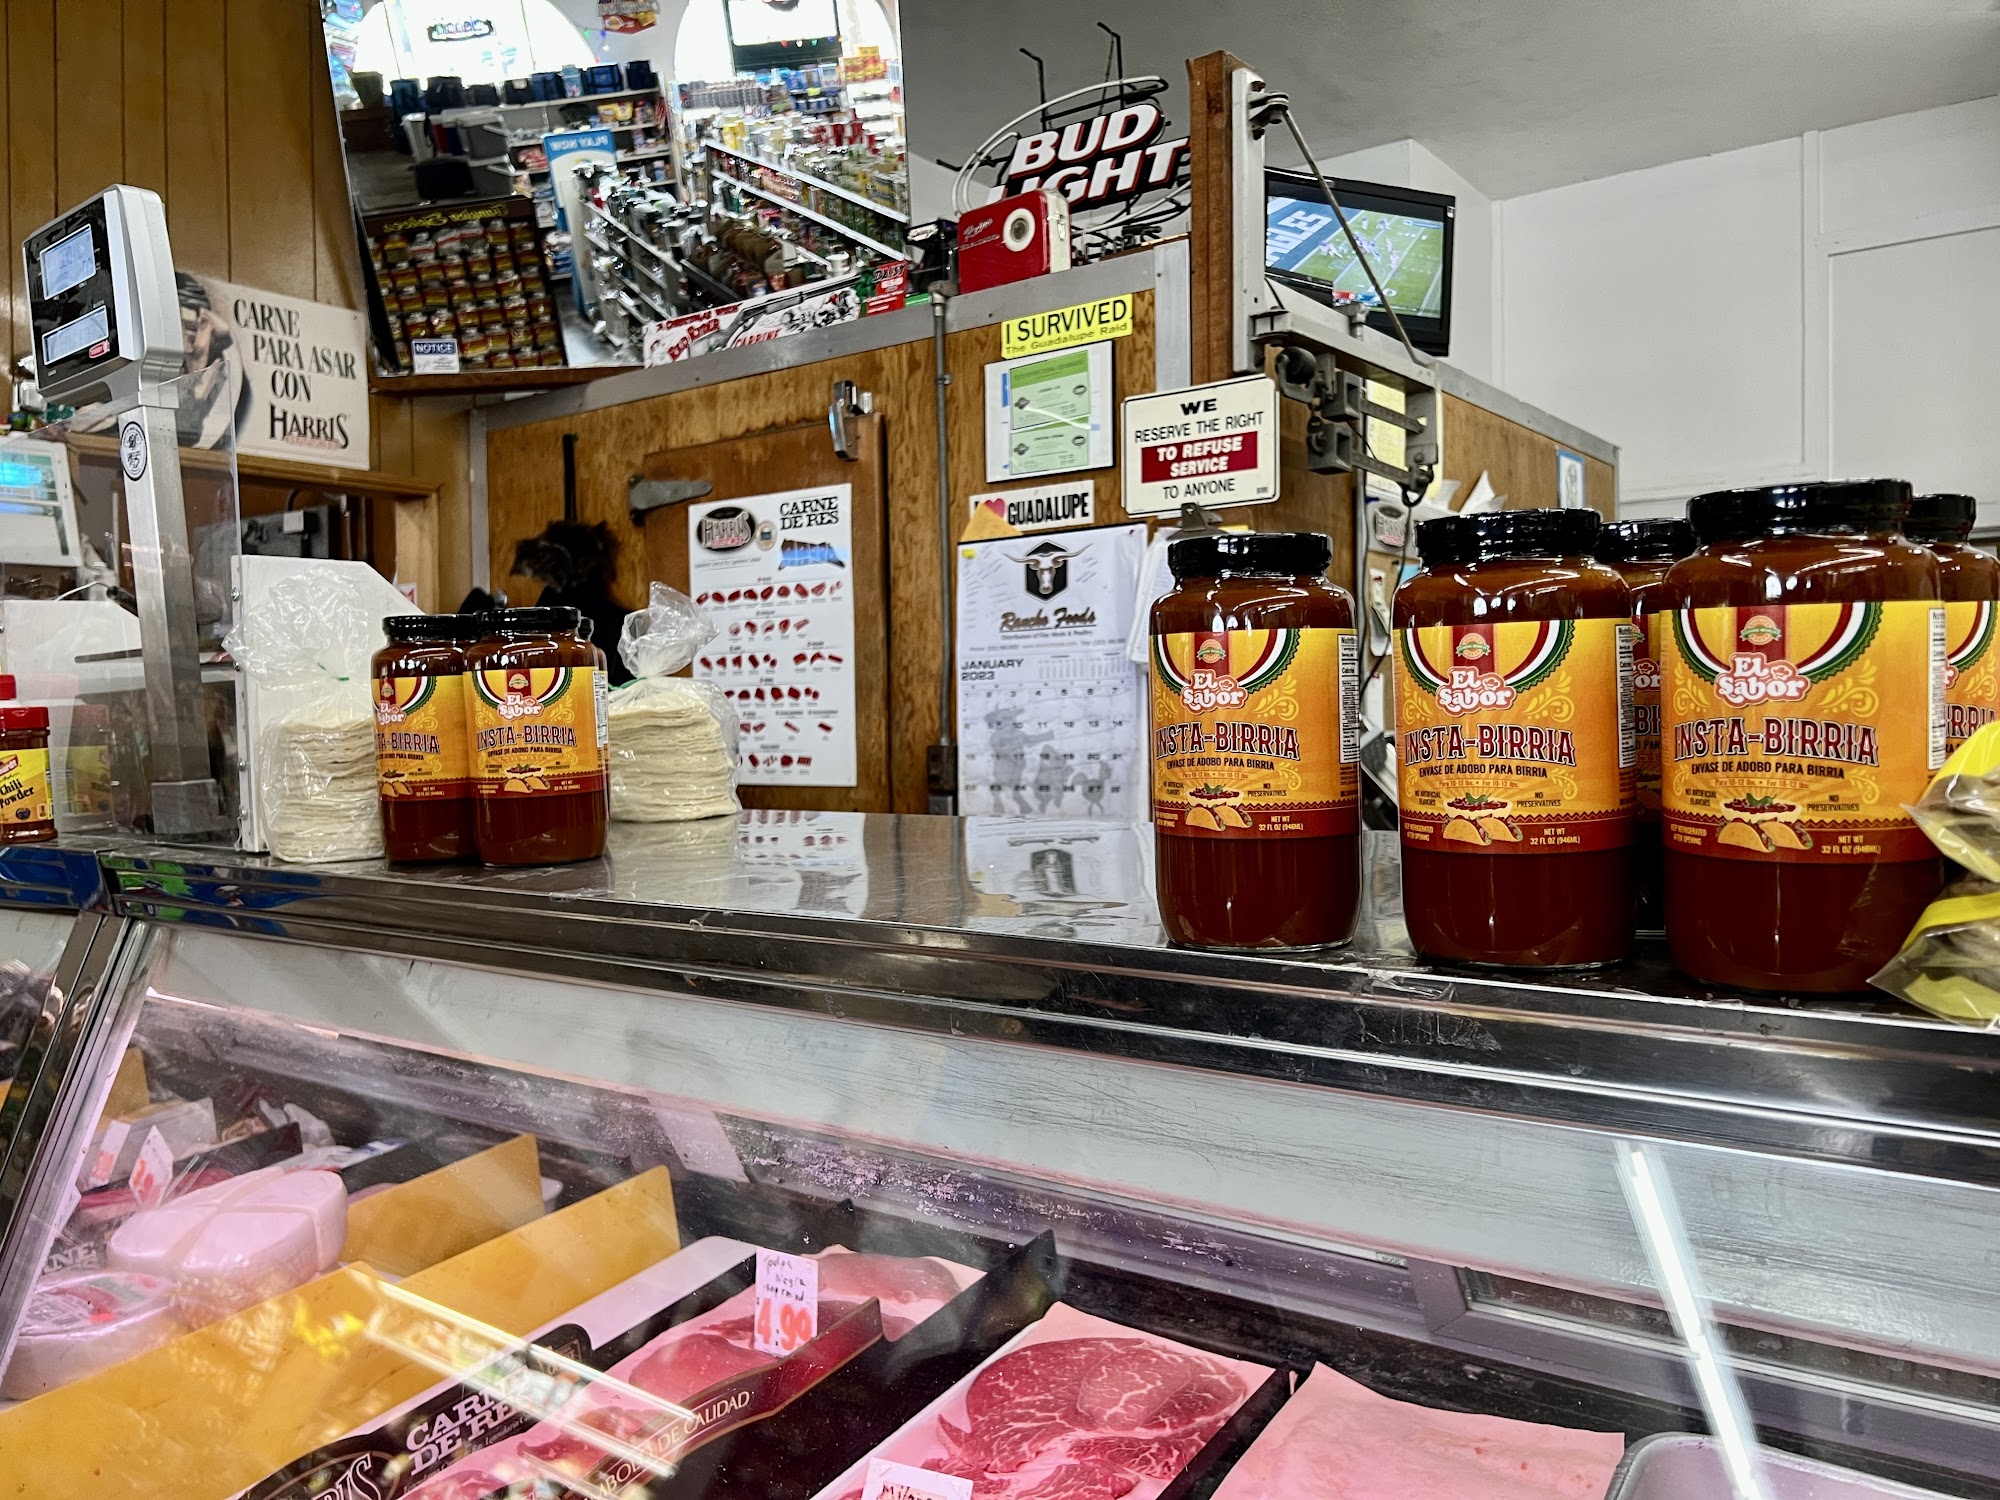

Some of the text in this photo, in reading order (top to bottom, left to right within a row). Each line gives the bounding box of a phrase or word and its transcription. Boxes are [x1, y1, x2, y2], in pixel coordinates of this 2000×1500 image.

[1009, 104, 1161, 175] BUD
[233, 299, 300, 338] CARNE
[1006, 299, 1127, 344] I SURVIVED
[415, 343, 453, 354] NOTICE
[1006, 322, 1127, 354] The Guadalupe Raid
[252, 334, 356, 380] PARA ASAR
[271, 369, 311, 403] CON
[1181, 398, 1217, 416] WE
[269, 401, 349, 449] HARRIS
[1135, 411, 1264, 444] RESERVE THE RIGHT
[1157, 436, 1243, 462] TO REFUSE
[1170, 456, 1229, 477] SERVICE
[1162, 478, 1235, 499] TO ANYONE
[780, 496, 838, 516] CARNE
[1008, 492, 1089, 526] GUADALUPE
[701, 510, 750, 547] HARRIS
[780, 510, 839, 531] DE RES
[1000, 607, 1096, 632] Rancho Foods
[961, 658, 1024, 670] JANUARY
[1734, 657, 1769, 678] El
[961, 672, 995, 681] 2023
[1193, 673, 1218, 690] El
[1452, 670, 1482, 689] El
[506, 694, 524, 706] El
[1183, 688, 1245, 711] Sabor
[1440, 688, 1511, 713] Sabor
[1718, 676, 1805, 704] Sabor
[377, 712, 405, 725] Sabor
[380, 703, 391, 713] El
[499, 704, 541, 719] Sabor
[377, 732, 441, 755] TA-BIRRIA
[477, 725, 577, 752] INSTA-BIRRIA
[1155, 721, 1301, 761] INSTA-BIRRIA
[1405, 723, 1577, 766] INSTA-BIRRIA
[1644, 740, 1660, 750] PAR
[1674, 716, 1879, 767] INSTA-BIRRIA
[1166, 757, 1275, 771] ENVASE DE ADOBO PARA BIRRIA
[1419, 764, 1548, 778] ENVASE DE ADOBO PARA BIRRIA
[1691, 761, 1845, 779] ENVASE DE ADOBO PARA BIRRIA
[0, 779, 23, 796] Chili
[1714, 779, 1727, 787] Para
[1728, 778, 1743, 787] 10-12
[1766, 779, 1777, 787] For
[0, 787, 34, 809] Powder
[1516, 799, 1561, 808] PRESERVATIVES
[1807, 803, 1859, 812] PRESERVATIVES
[1544, 828, 1565, 836] NET WT
[1547, 837, 1556, 845] OZ
[1838, 835, 1851, 844] NET
[1821, 845, 1831, 854] 32
[657, 1391, 751, 1452] DE CALIDAD
[408, 1428, 462, 1476] DE
[466, 1402, 519, 1442] RE
